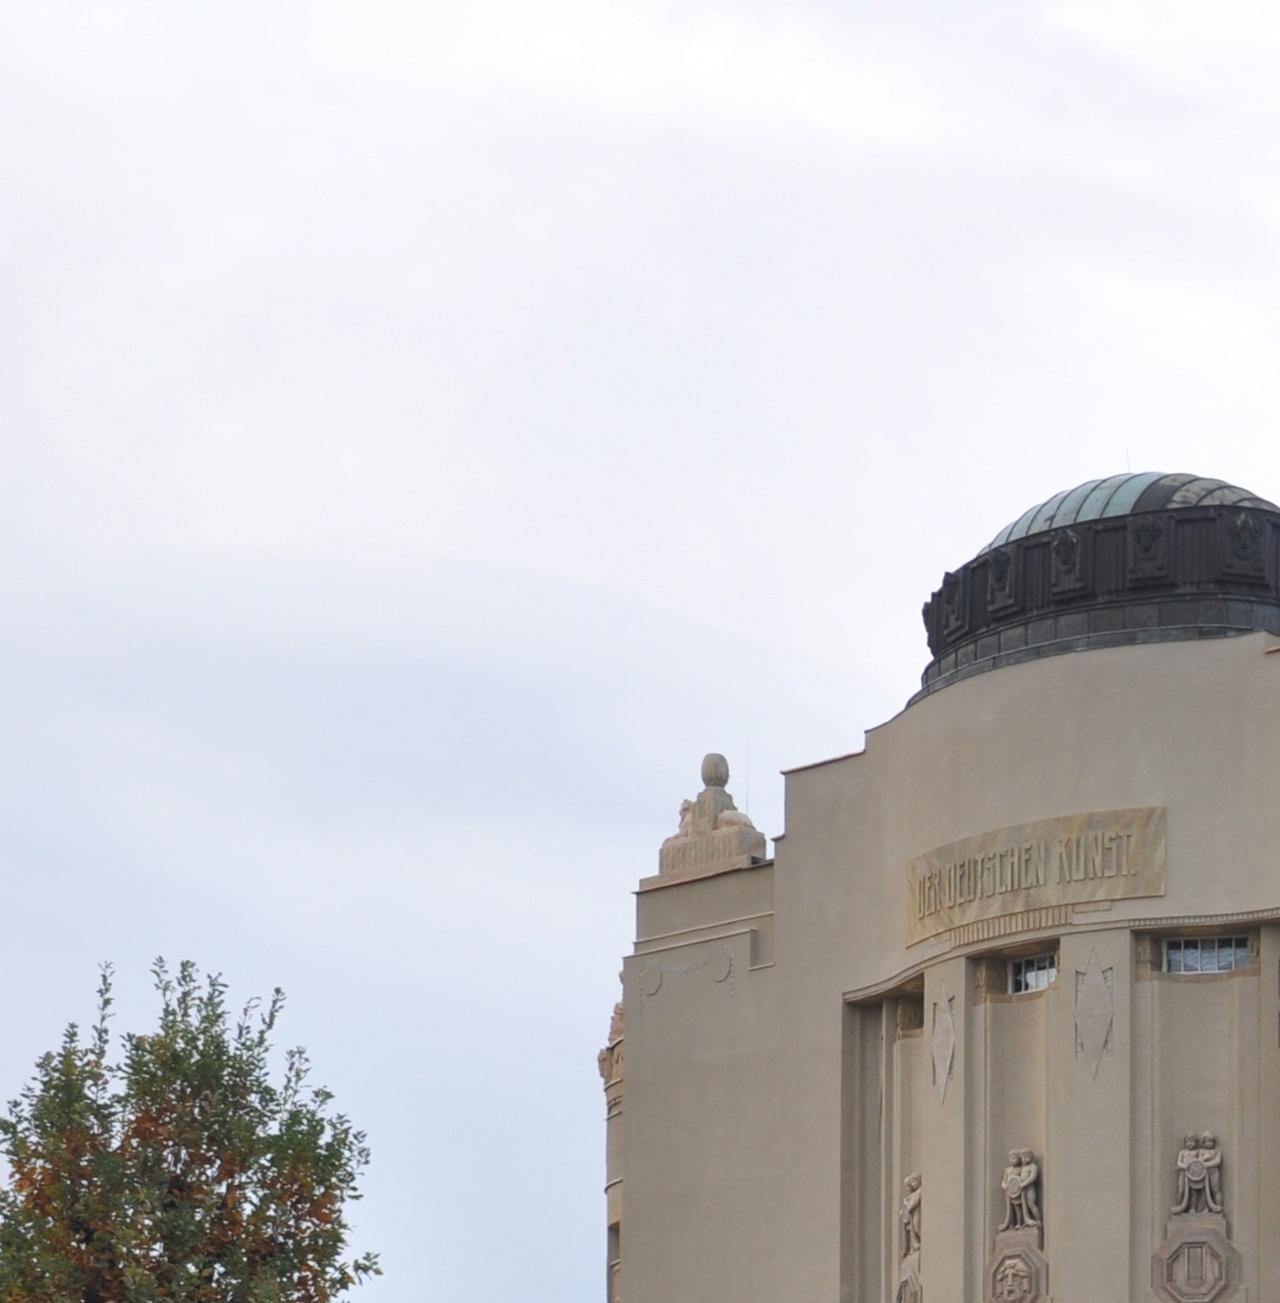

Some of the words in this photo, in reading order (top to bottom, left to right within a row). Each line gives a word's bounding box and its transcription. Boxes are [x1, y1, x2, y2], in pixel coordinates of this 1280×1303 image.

[917, 868, 943, 920] DER
[945, 842, 1046, 909] DEUTSCHEN
[1057, 832, 1136, 884] KUNST.
